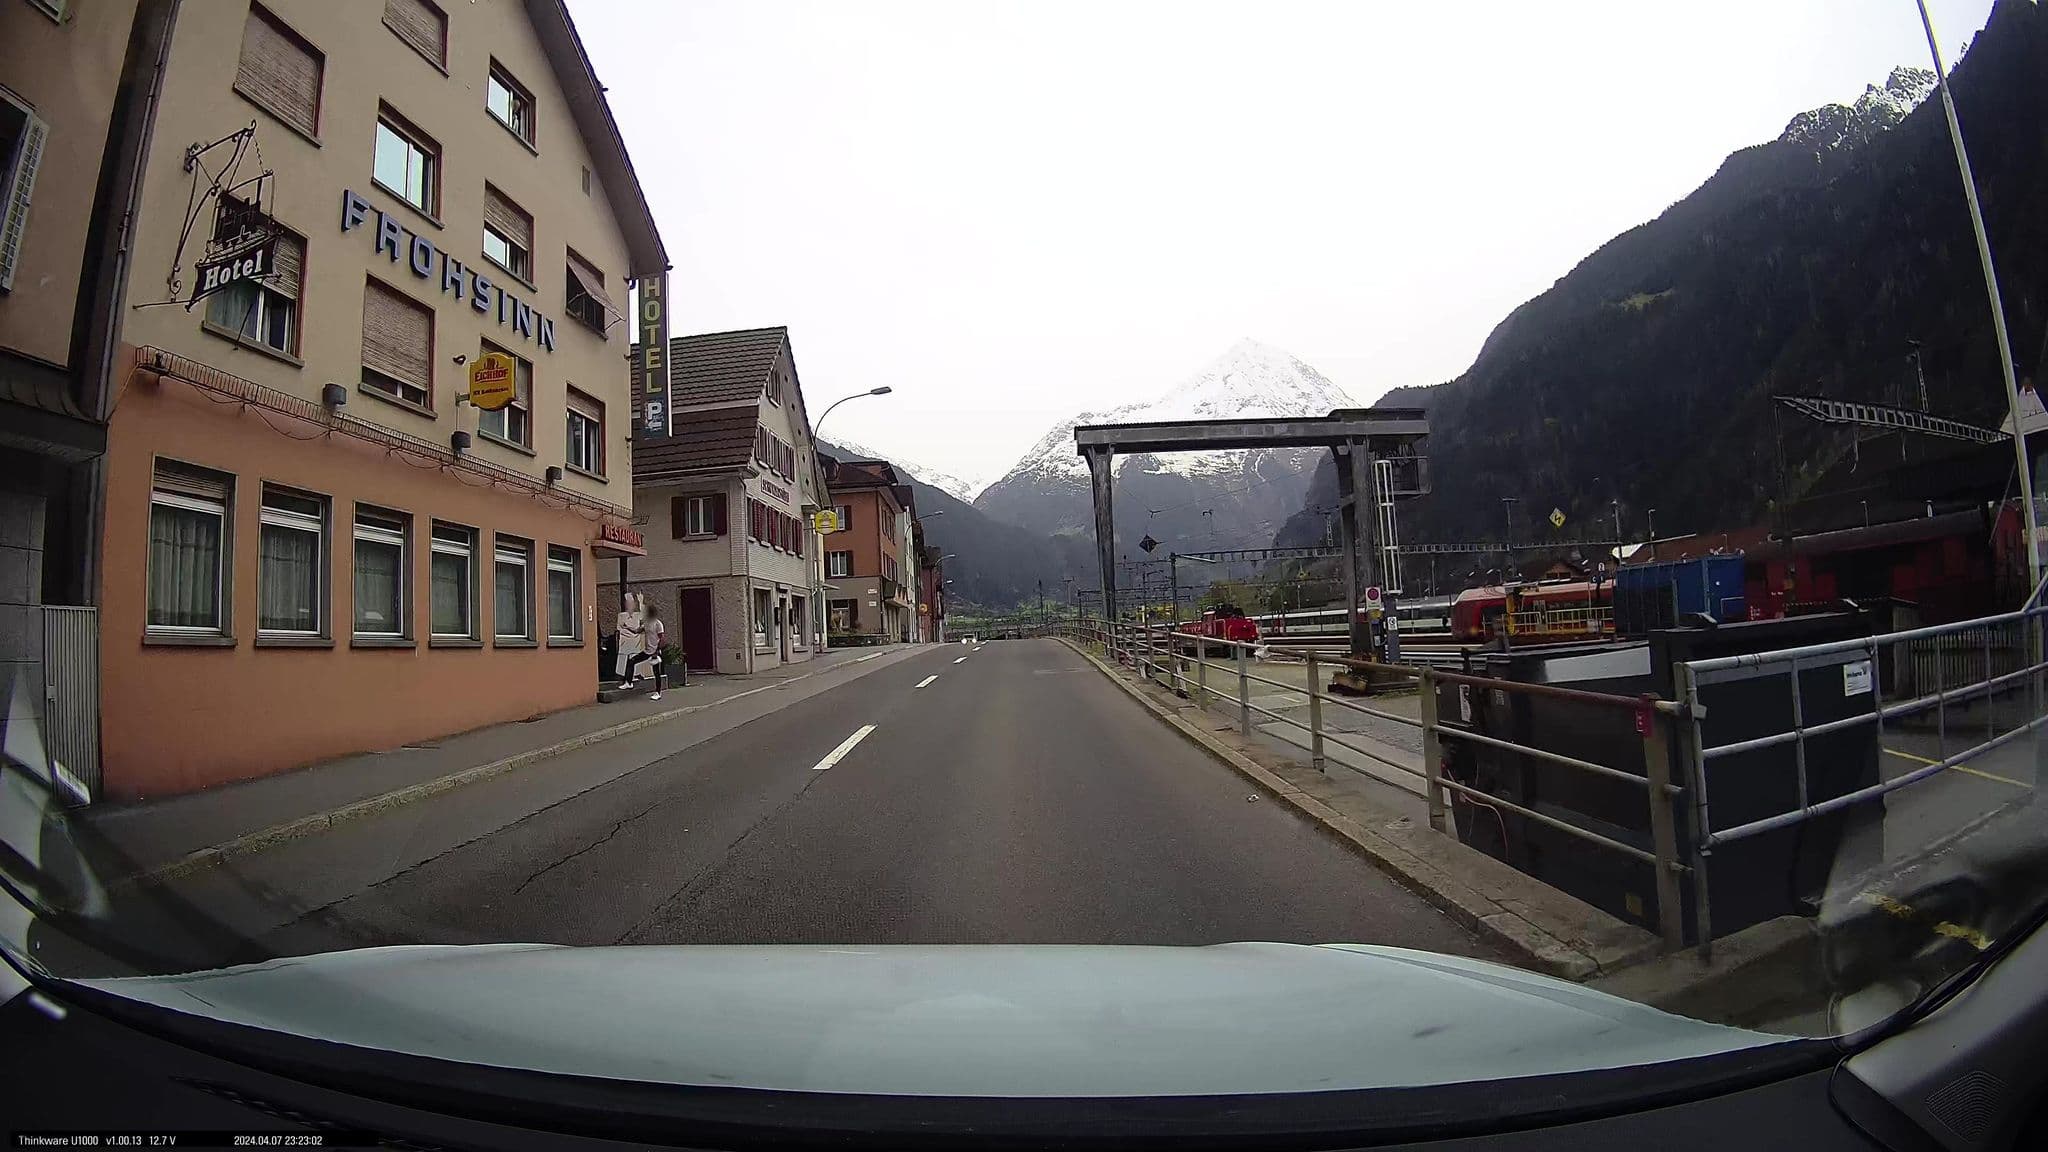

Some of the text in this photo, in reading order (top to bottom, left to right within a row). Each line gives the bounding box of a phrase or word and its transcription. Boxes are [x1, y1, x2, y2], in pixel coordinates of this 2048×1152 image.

[203, 249, 263, 291] Hotel
[341, 189, 555, 351] FROHSINN
[644, 277, 662, 394] HOTEL
[475, 369, 508, 382] EICHHOF
